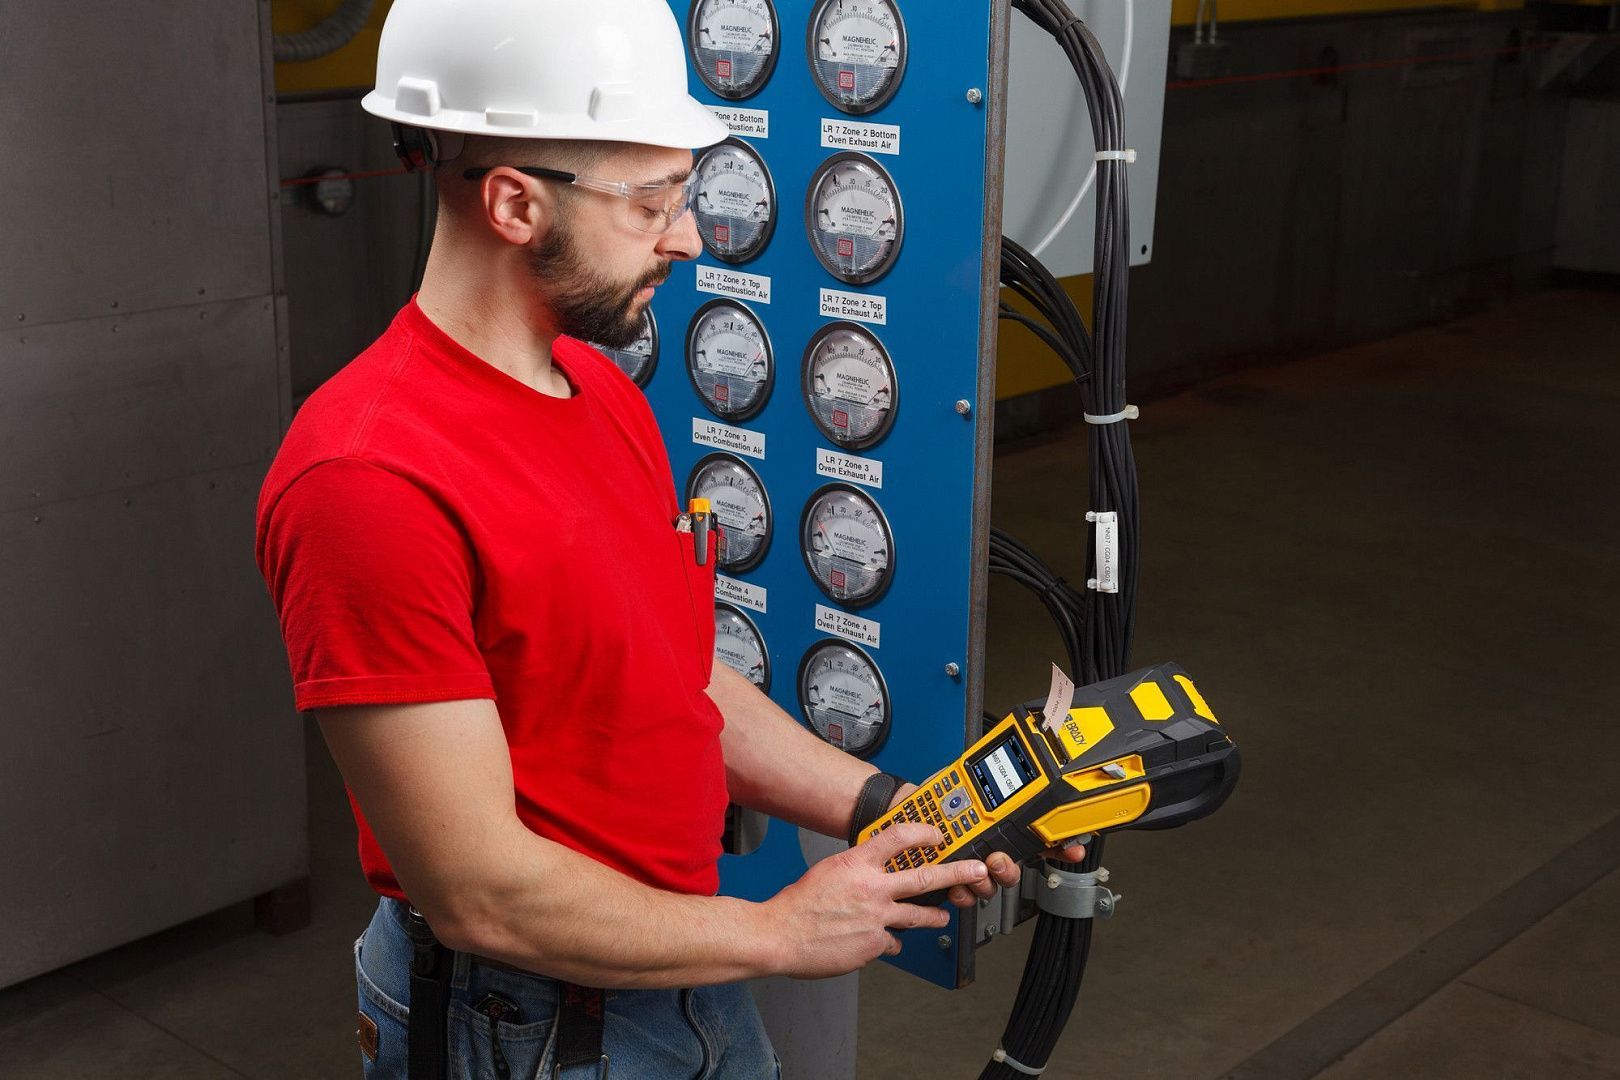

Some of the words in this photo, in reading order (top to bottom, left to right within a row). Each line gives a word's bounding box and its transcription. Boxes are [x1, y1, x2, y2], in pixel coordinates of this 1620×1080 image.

[842, 35, 876, 45] MAGNEHELIC
[740, 114, 764, 123] Bottom
[727, 123, 753, 132] bustion
[823, 125, 832, 133] LR
[842, 127, 860, 136] Zone
[870, 130, 897, 140] Bottom
[828, 135, 846, 144] Oven
[849, 137, 878, 148] Exhaust
[881, 141, 891, 149] Air
[698, 280, 715, 289] Oven
[717, 283, 756, 297] Combustion
[705, 272, 714, 280] LR
[723, 275, 739, 284] Zone
[748, 280, 760, 290] Top
[823, 294, 832, 302] LR
[842, 297, 859, 306] Zone
[870, 301, 882, 311] Top
[822, 304, 839, 313] Oven
[842, 307, 870, 318] Exhaust
[707, 426, 716, 434] LR
[724, 430, 740, 440] Zone
[694, 432, 710, 442] Oven
[713, 436, 750, 451] Combustion
[753, 446, 762, 454] Air
[825, 456, 835, 464] LR
[844, 460, 862, 470] Zone
[818, 463, 836, 473] Oven
[838, 468, 866, 480] Exhaust
[869, 475, 879, 483] Air
[726, 583, 742, 593] Zone
[716, 587, 752, 605] Combustion
[755, 600, 764, 608] Air
[824, 612, 834, 621] LR
[843, 618, 860, 629] Zone
[817, 619, 834, 630] Oven
[837, 625, 864, 639] Exhaust
[867, 635, 877, 643] Air
[1066, 720, 1087, 746] BRADY
